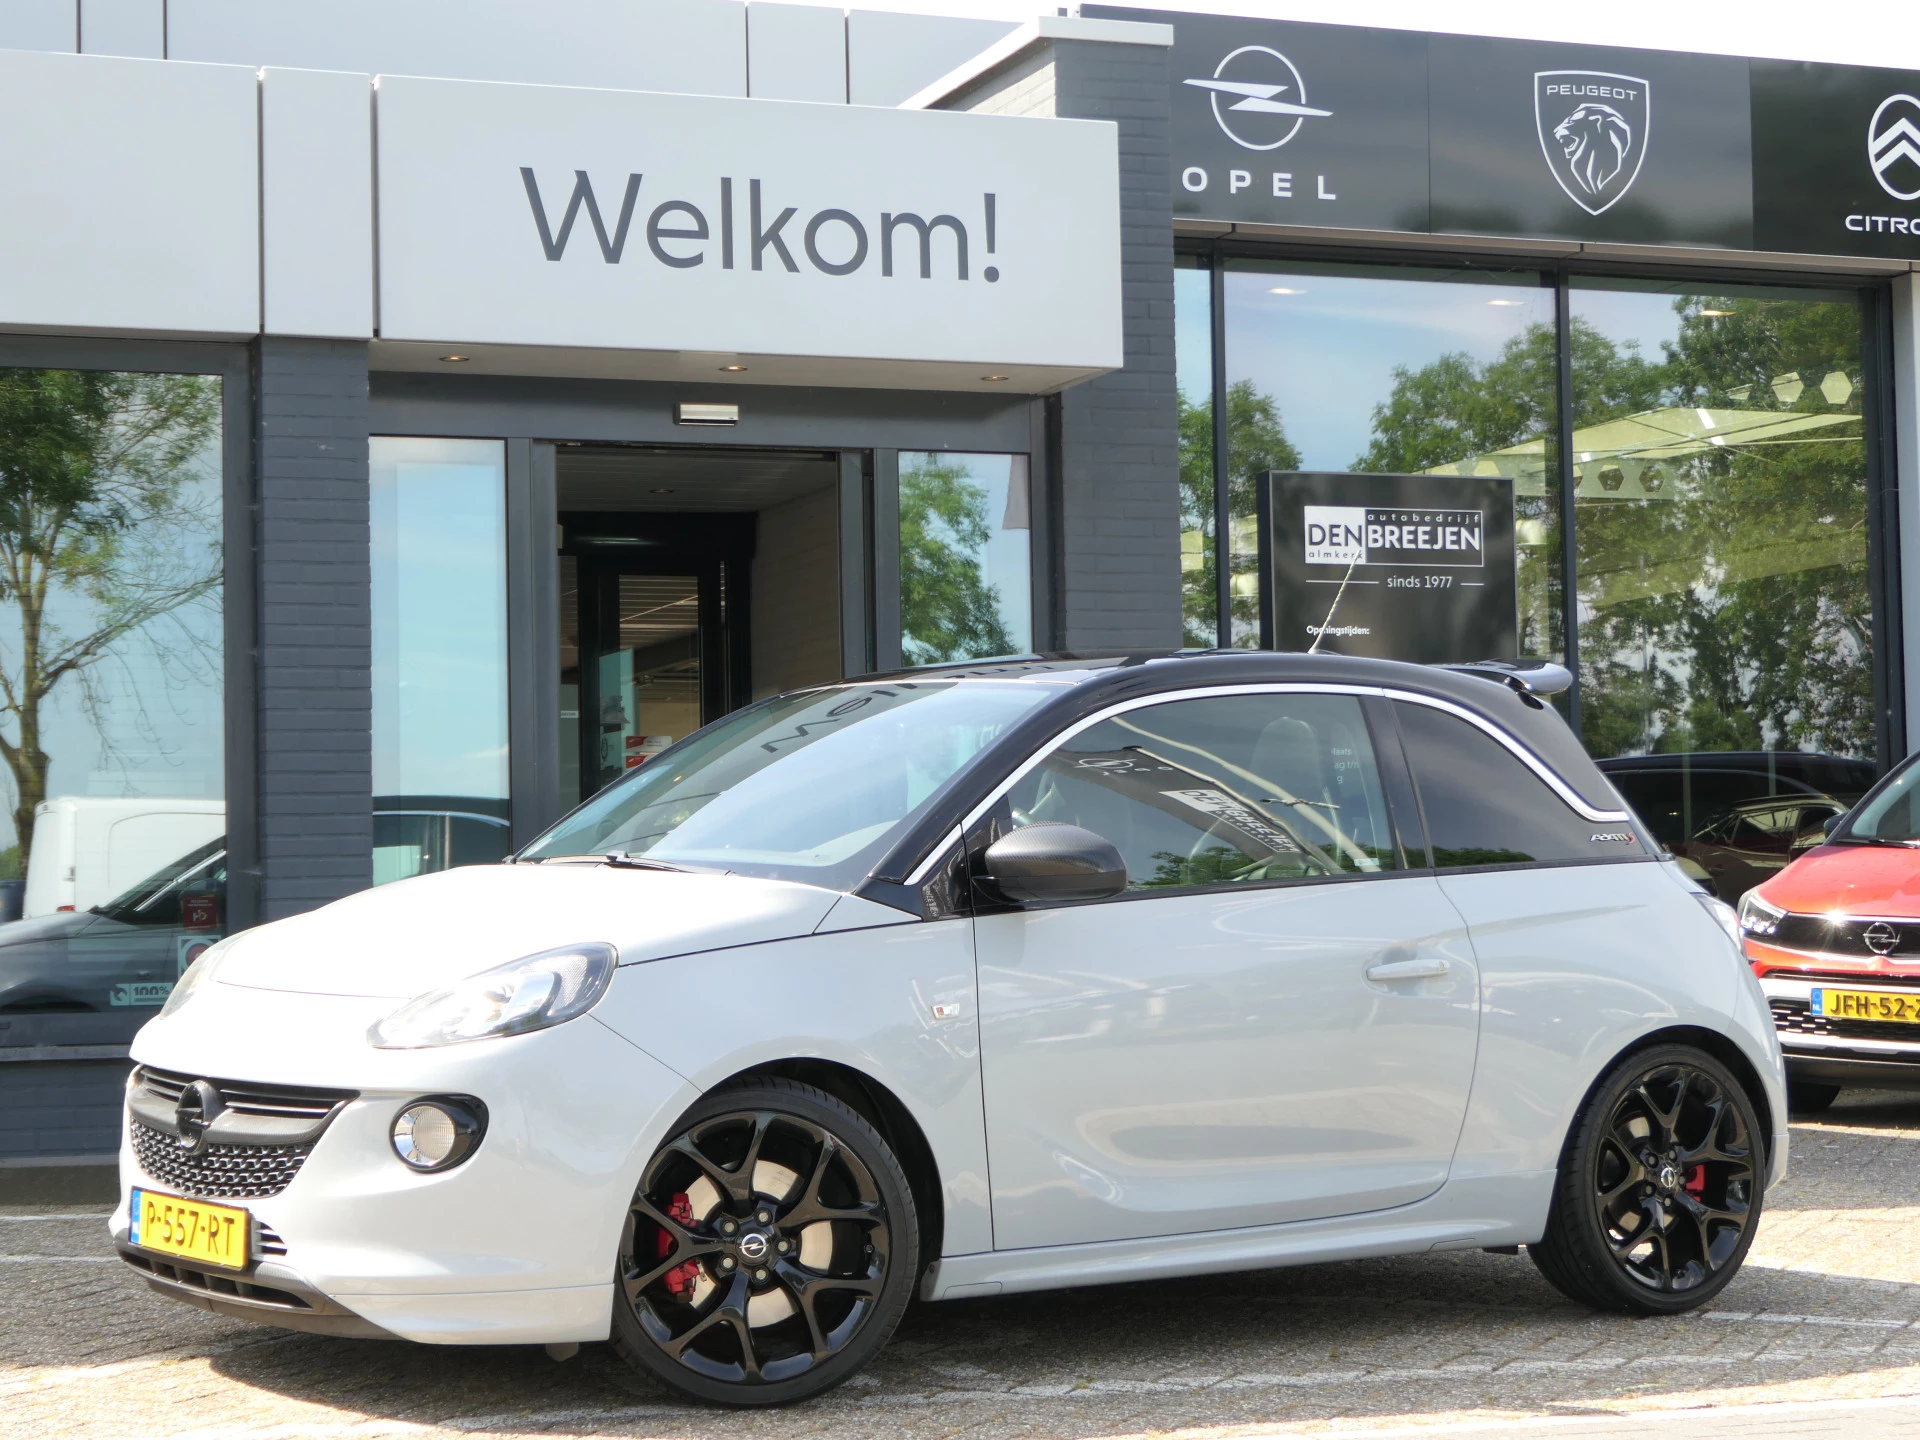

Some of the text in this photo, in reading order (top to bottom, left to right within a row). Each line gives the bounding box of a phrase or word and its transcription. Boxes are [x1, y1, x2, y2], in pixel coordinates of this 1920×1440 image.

[1546, 84, 1638, 101] PEUGEOT
[1182, 166, 1337, 201] OPEL
[519, 166, 1000, 283] Welkom!
[1367, 513, 1479, 525] autobedrijf
[1387, 575, 1453, 589] sinds 1977
[146, 1201, 235, 1256] P-557-RT
